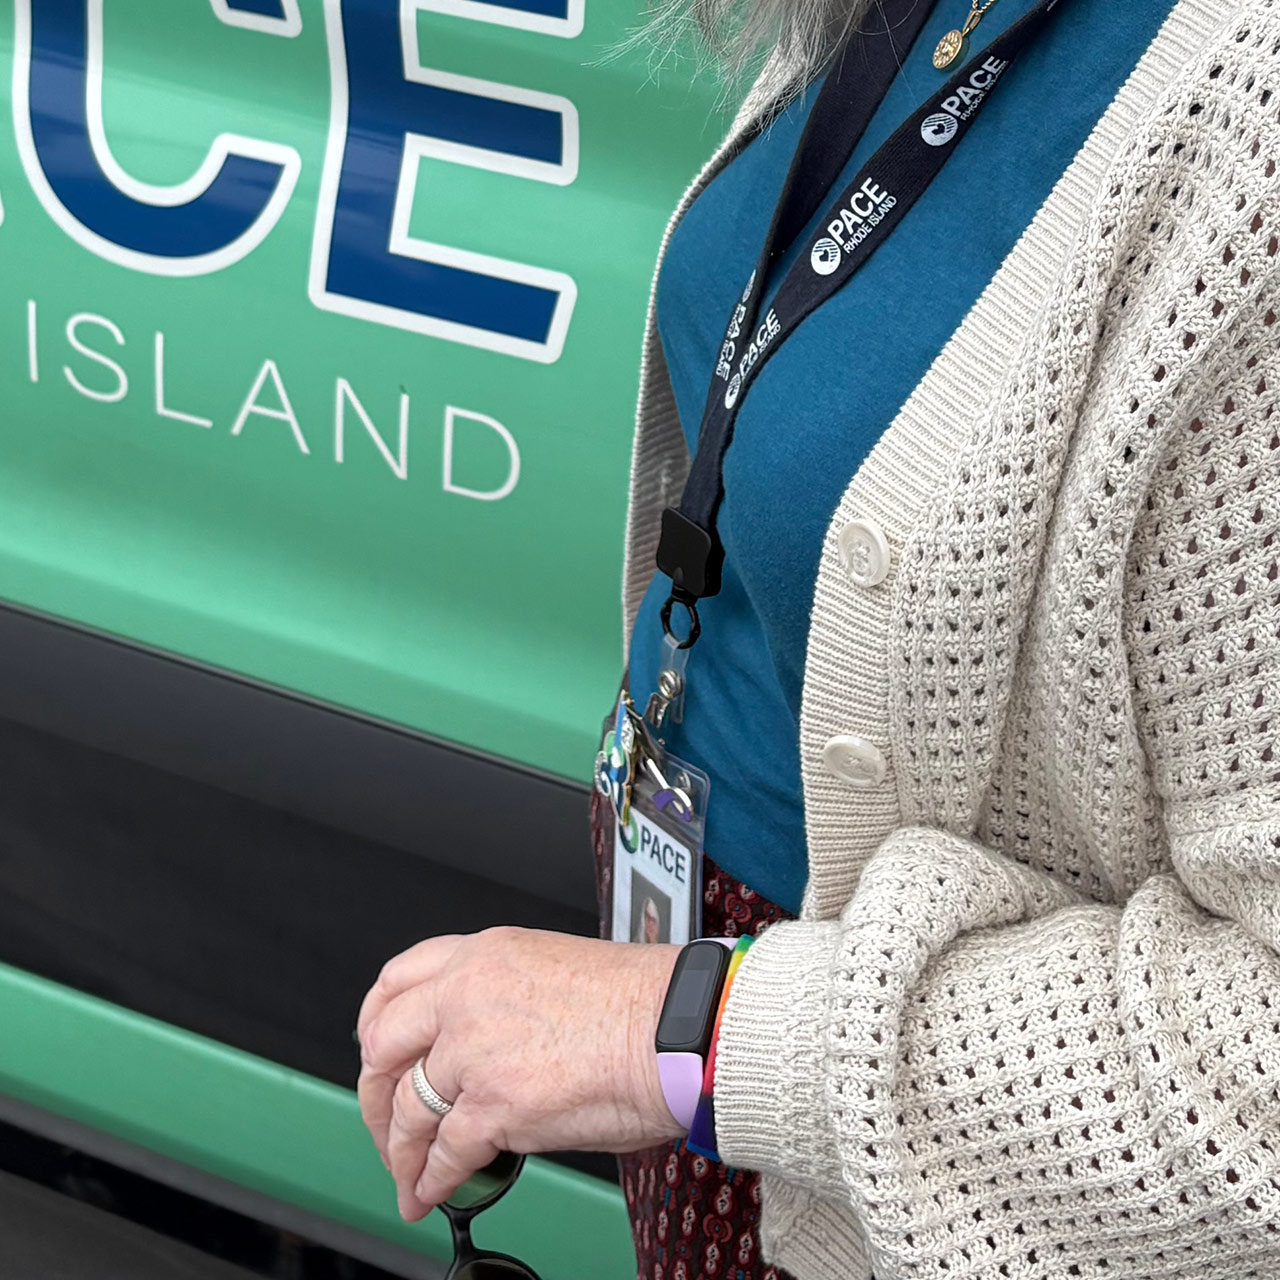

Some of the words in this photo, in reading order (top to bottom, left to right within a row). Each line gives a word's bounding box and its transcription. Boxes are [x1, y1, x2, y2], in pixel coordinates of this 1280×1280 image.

[940, 55, 1006, 118] PACE
[827, 177, 889, 247] PACE
[843, 221, 873, 255] RHODE
[868, 195, 898, 233] ISLAND
[720, 305, 747, 382] PACE
[739, 308, 779, 378] PACE
[25, 298, 524, 503] ISLAND
[640, 825, 686, 884] PACE
